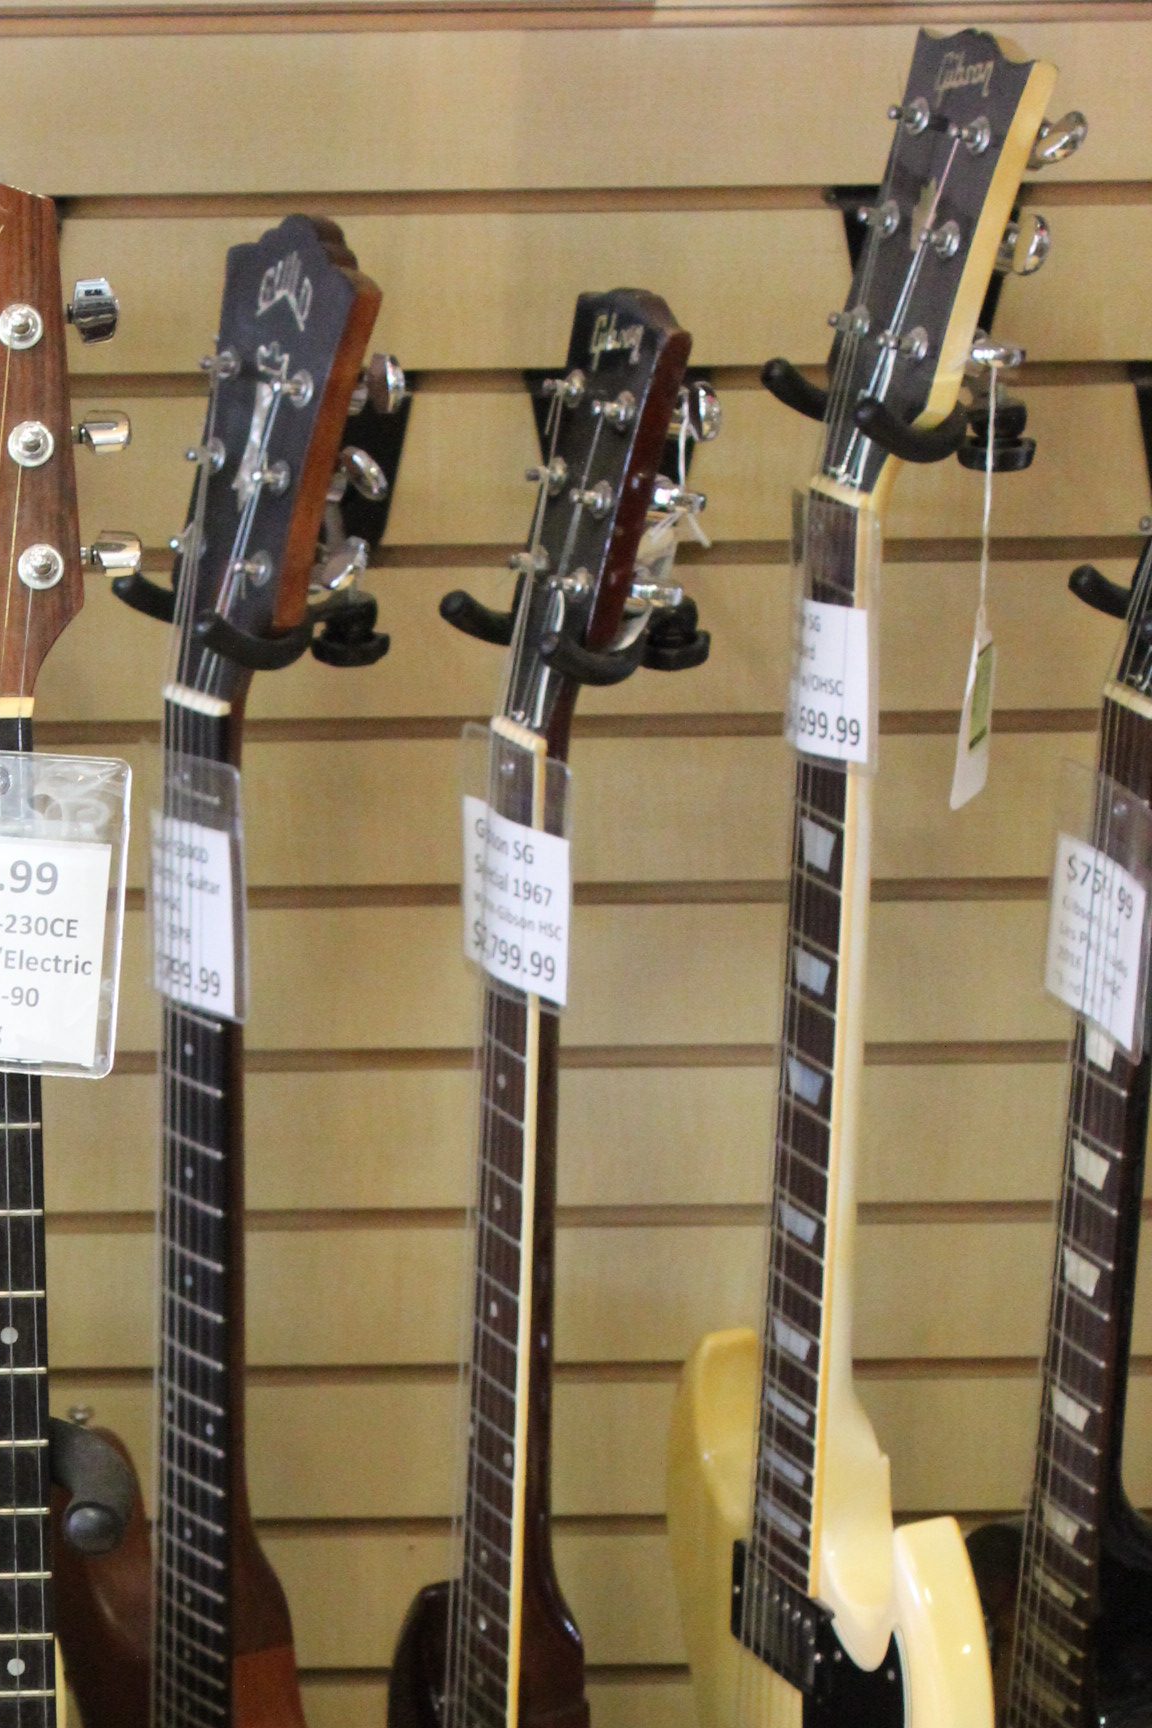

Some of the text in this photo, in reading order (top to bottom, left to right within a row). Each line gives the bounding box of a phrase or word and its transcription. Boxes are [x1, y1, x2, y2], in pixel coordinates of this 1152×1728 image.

[512, 841, 535, 865] SG
[512, 878, 553, 908] 1967
[538, 920, 563, 942] HSC
